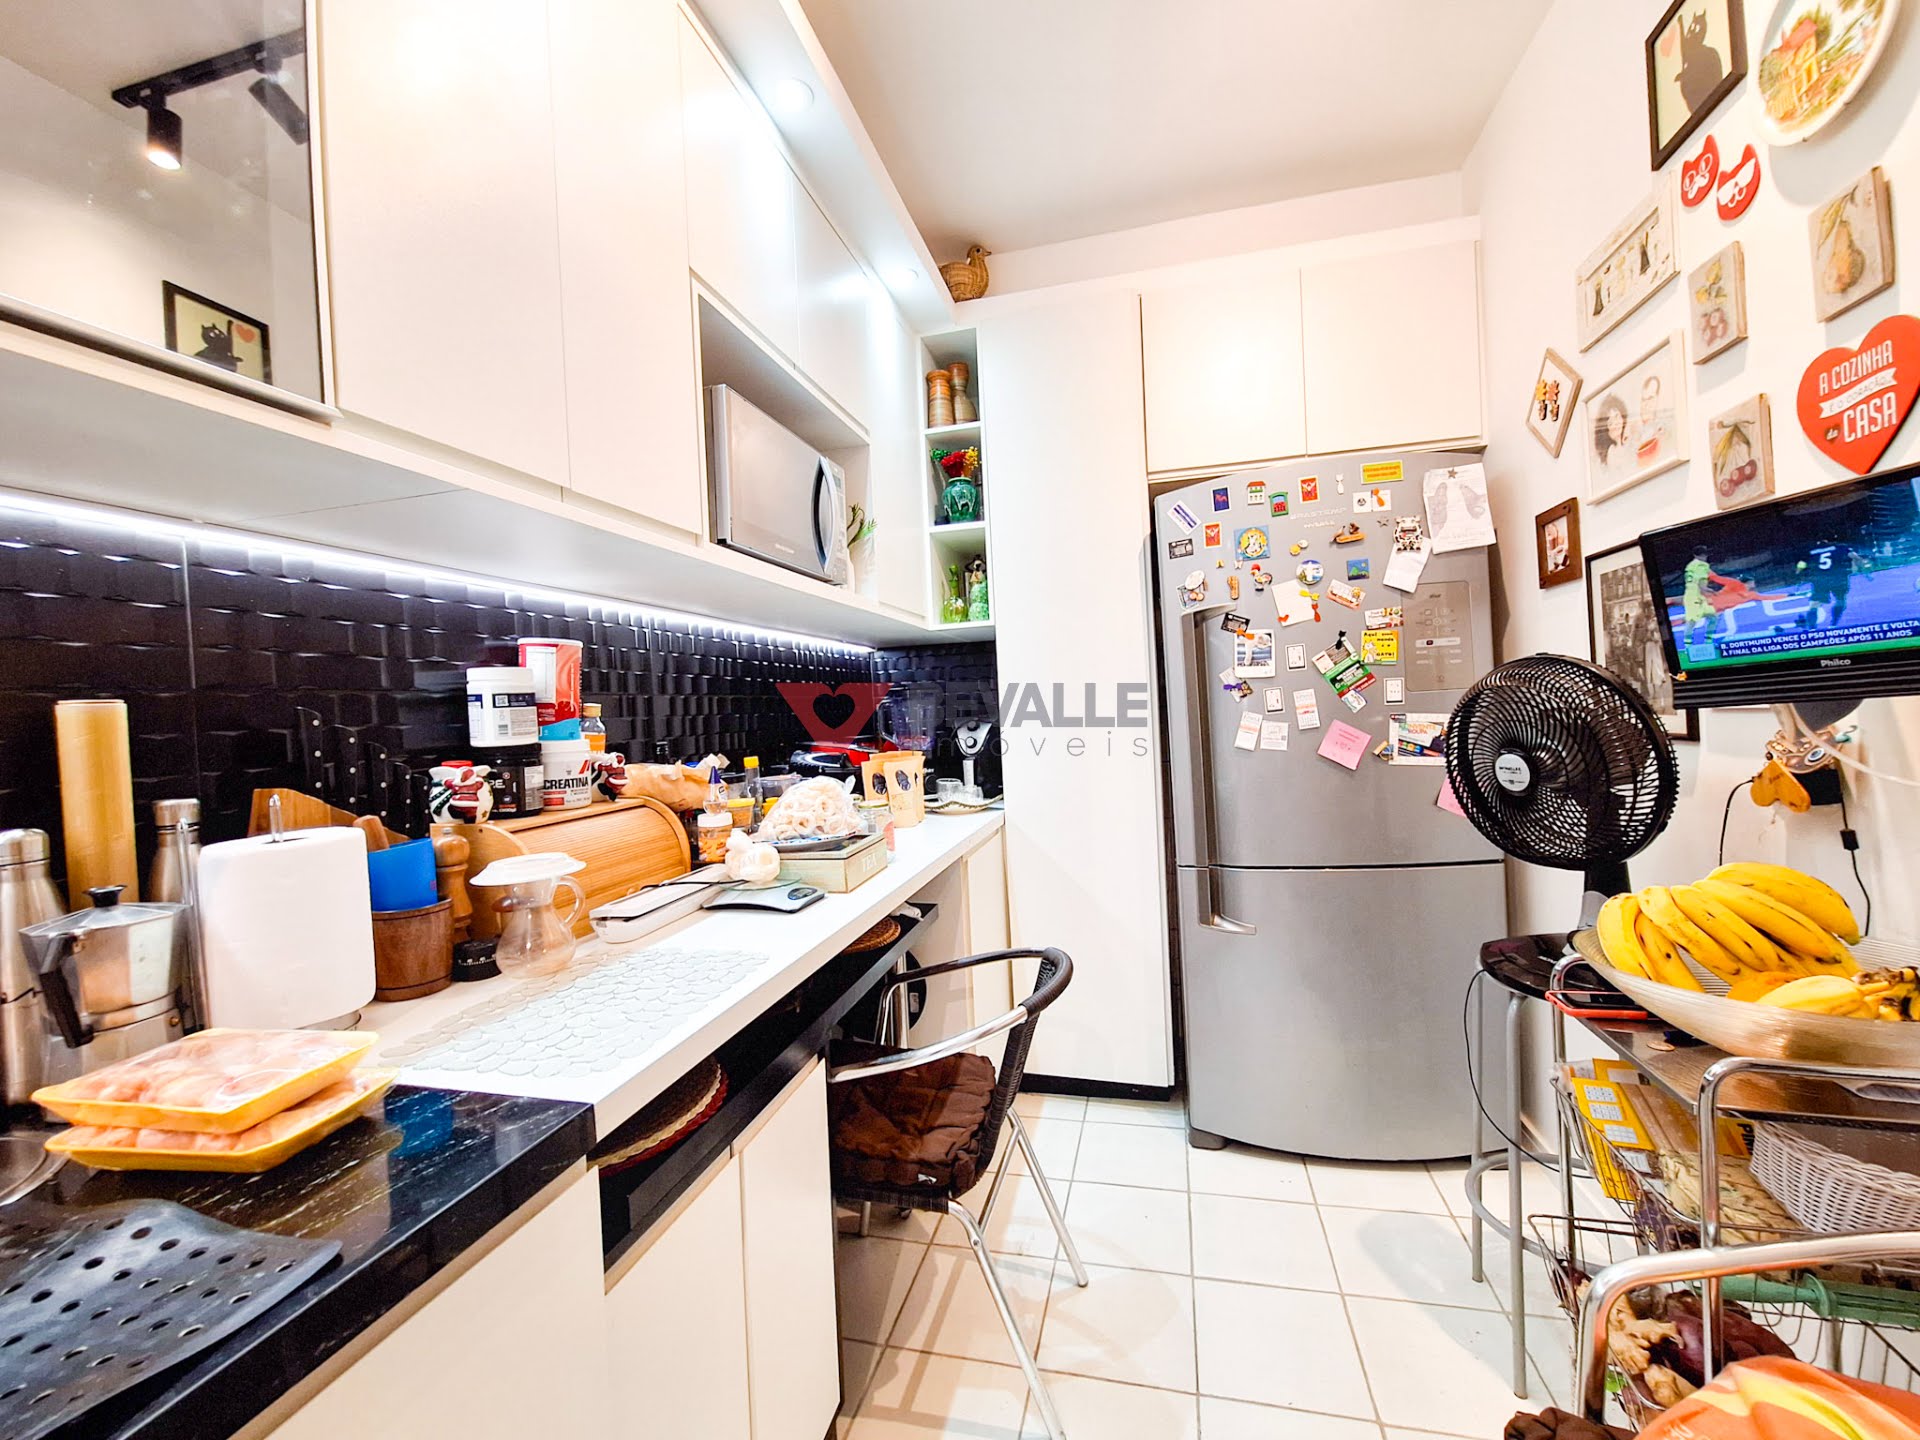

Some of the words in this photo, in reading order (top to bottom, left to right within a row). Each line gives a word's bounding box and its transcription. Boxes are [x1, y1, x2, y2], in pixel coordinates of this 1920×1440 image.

[1819, 372, 1828, 397] A
[1831, 339, 1893, 390] COZINHA
[1843, 391, 1897, 443] CASA
[1819, 552, 1832, 570] 5
[1729, 638, 1772, 649] DORTMUND
[1772, 634, 1800, 643] VENCE
[1808, 631, 1825, 640] PSG
[1826, 624, 1881, 637] NOVAMENTE
[1890, 620, 1920, 630] VOLTA
[1729, 647, 1751, 656] FINAL
[1763, 644, 1782, 652] LIGA
[1783, 642, 1799, 650] DOS
[1800, 636, 1847, 648] CAMPEÕES
[1848, 633, 1872, 642] APÓS
[1886, 629, 1913, 639] ANOS
[1820, 658, 1852, 667] Philco
[544, 776, 589, 790] CREATINA
